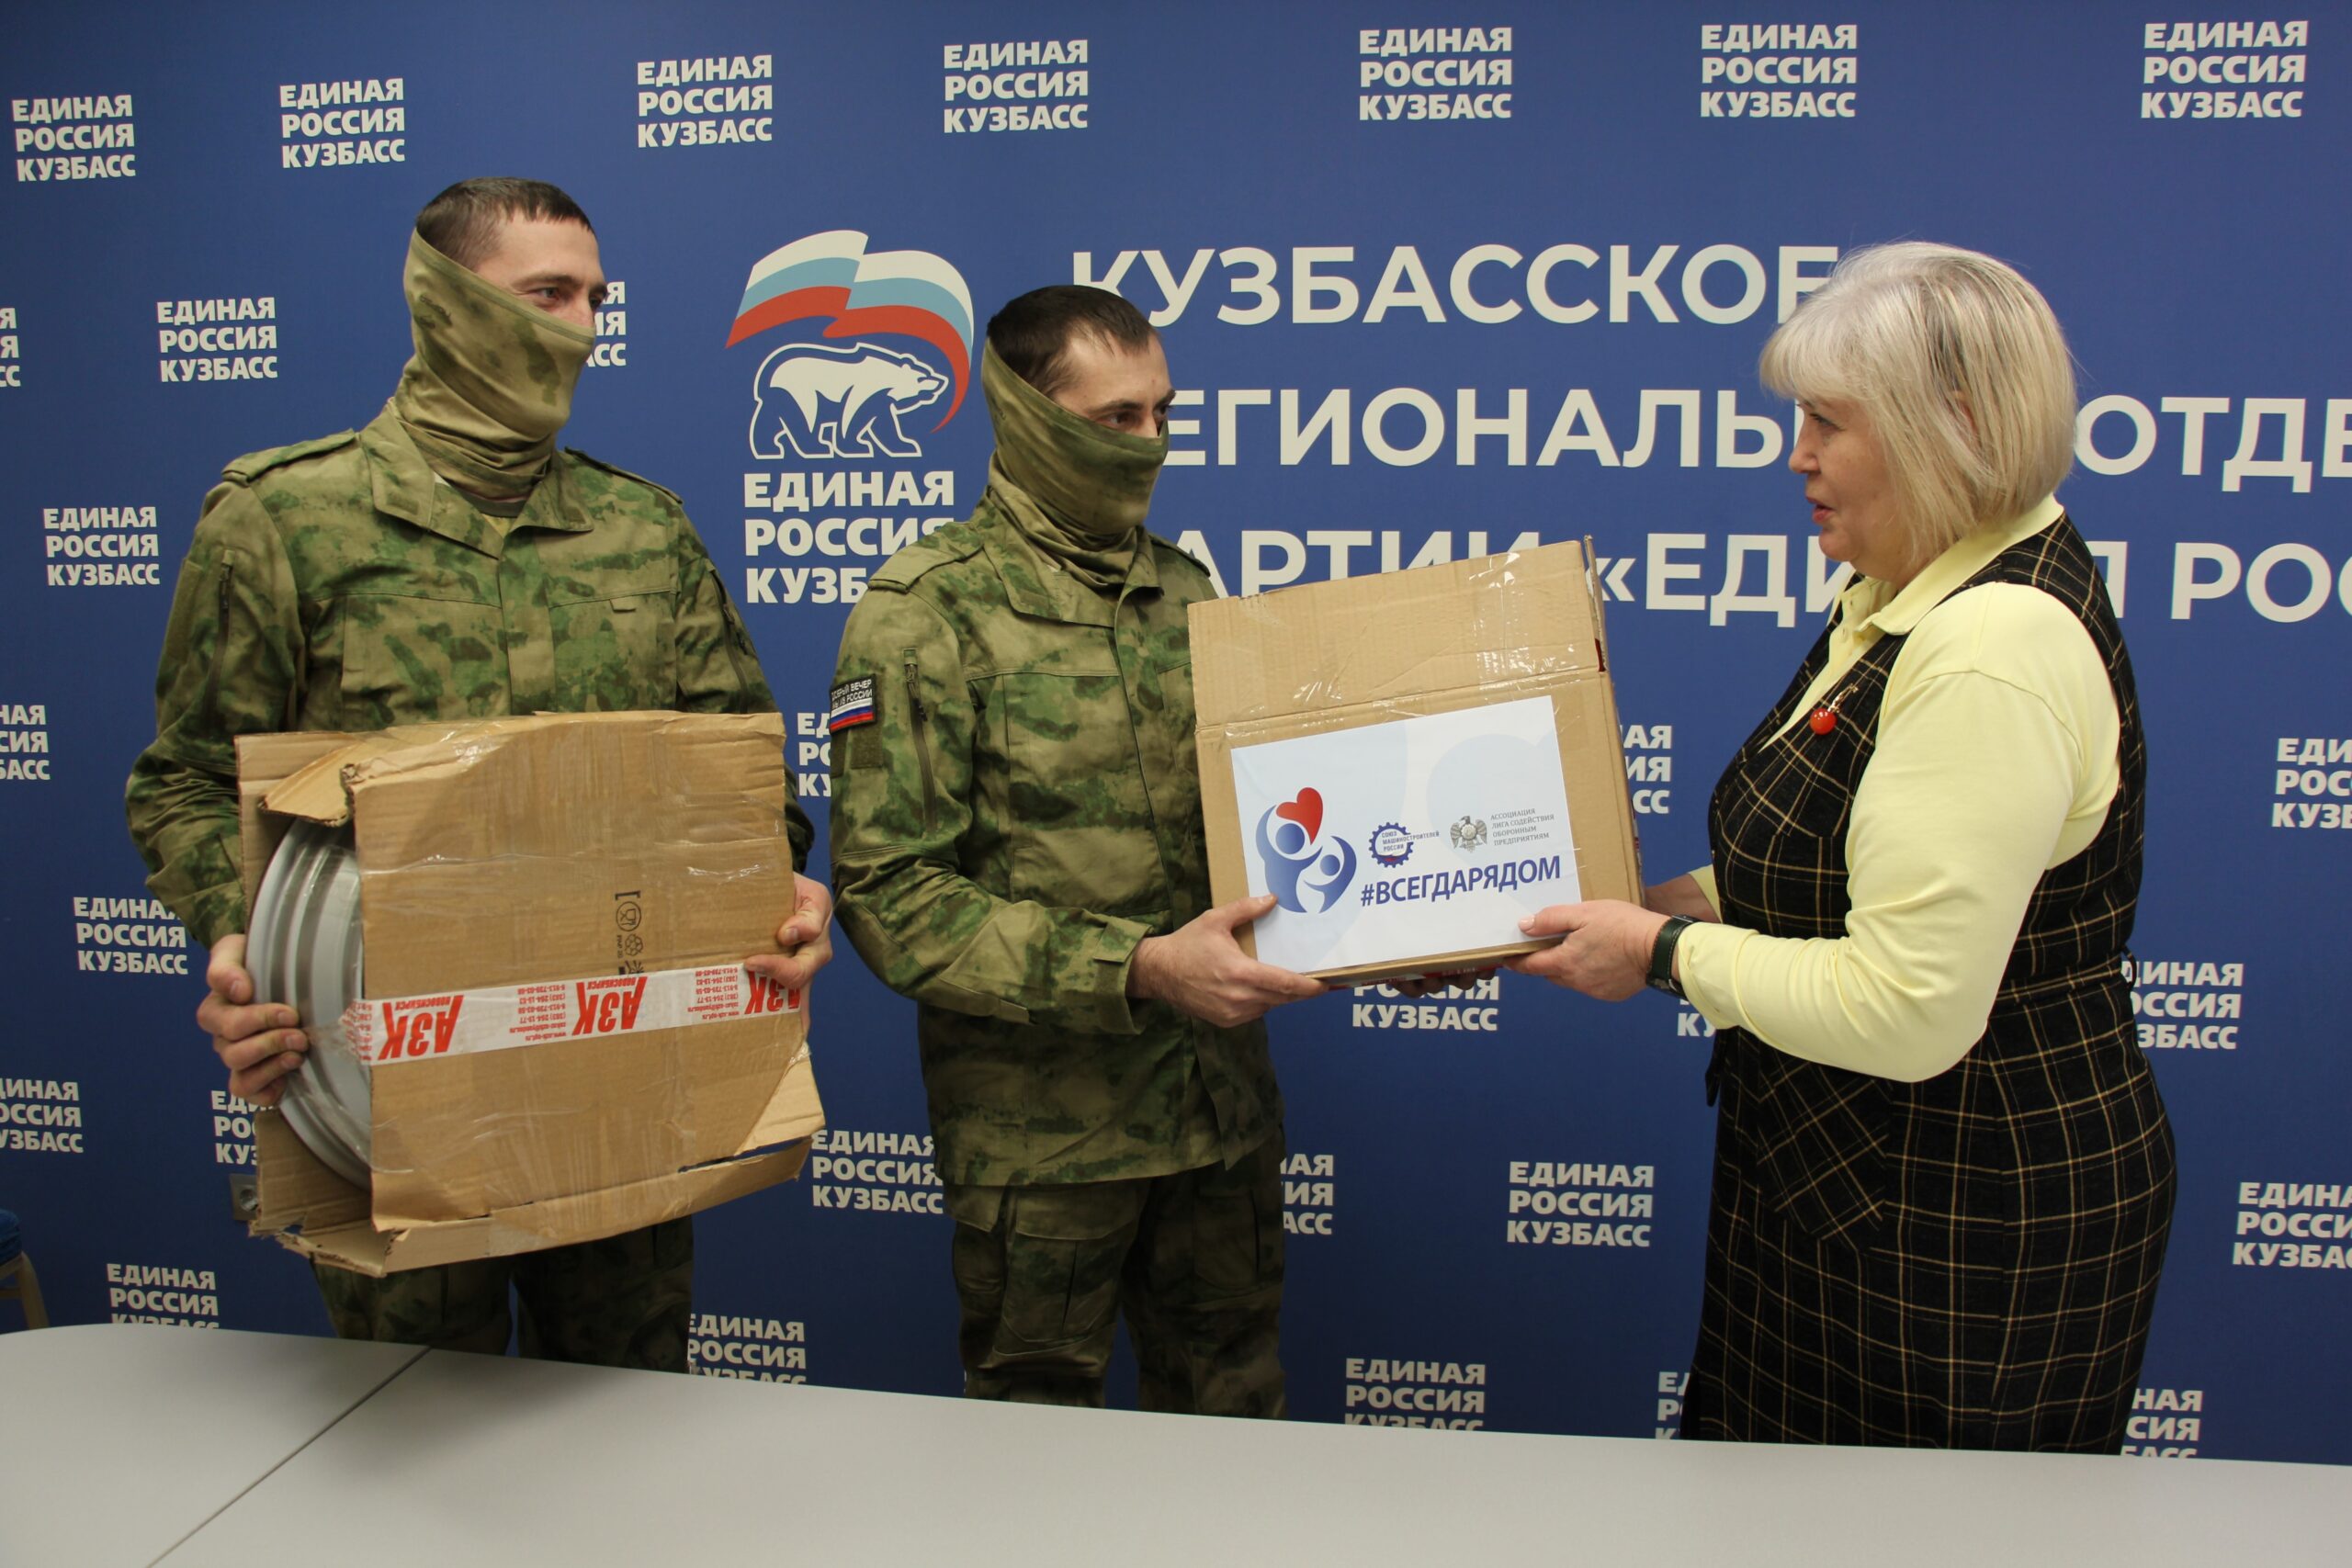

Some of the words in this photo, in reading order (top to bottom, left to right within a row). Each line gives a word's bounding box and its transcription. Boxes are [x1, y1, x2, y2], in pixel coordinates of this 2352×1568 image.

[1360, 28, 1511, 56] ЕДИНАЯ
[1702, 25, 1857, 52] ЕДИНАЯ
[2145, 20, 2308, 51] ЕДИНАЯ
[944, 39, 1088, 71] ЕДИНАЯ
[638, 54, 772, 86] ЕДИНАЯ
[1361, 59, 1512, 87] РОССИЯ
[1702, 57, 1857, 84] РОССИЯ
[2145, 54, 2306, 84] РОССИЯ
[279, 78, 403, 109] ЕДИНАЯ
[945, 71, 1088, 100] РОССИЯ
[12, 95, 132, 124] ЕДИНАЯ
[639, 85, 772, 116] РОССИЯ
[1360, 93, 1512, 120] КУЗБАСС
[1702, 91, 1856, 117] КУЗБАСС
[2143, 91, 2303, 118] КУЗБАСС
[281, 107, 404, 138] РОССИЯ
[944, 104, 1088, 132] КУЗБАСС
[16, 124, 134, 152] РОССИЯ
[638, 118, 772, 147] КУЗБАСС
[282, 139, 404, 168] КУЗБАСС
[17, 154, 135, 181] КУЗБАСС
[1073, 243, 1838, 326] КУЗБАССКОЕ
[157, 297, 275, 325] ЕДИНАЯ
[159, 326, 277, 353] РОССИЯ
[160, 356, 277, 382] КУЗБАСС
[1163, 387, 1804, 468] ЕГИОНАЛЬ
[744, 470, 954, 513] ЕДИНАЯ
[43, 507, 156, 531] ЕДИНАЯ
[46, 535, 158, 558] РОССИЯ
[47, 564, 160, 585] КУЗБАСС
[747, 567, 868, 604] КУЗБ
[2171, 542, 2352, 623] РО
[847, 689, 872, 702] РОССИИ
[851, 679, 872, 692] ВЕЧЕР
[1491, 808, 1535, 820] АССОЦИАЦИЯ
[1492, 821, 1510, 829] ЛИГА
[1510, 814, 1555, 826] СОДЕЙСТВИЯ
[1383, 830, 1439, 844] МАШИНОСТРОИТЕЛЕЙ
[1493, 826, 1536, 838] ОБОРОННЫМ
[1494, 832, 1549, 845] ПРЕДПРИЯТИЯМ
[1361, 855, 1560, 907] #ВСЕГДАРЯДОМ
[74, 897, 180, 920] ЕДИНА
[76, 923, 187, 948] РОССИЯ
[78, 951, 187, 975] КУЗБАСС
[2121, 961, 2244, 987] ДИНАЯ
[571, 976, 648, 1036] АЗК
[1352, 1004, 1498, 1031] КУЗБАСС
[2130, 990, 2242, 1019] ССИЯ
[378, 995, 464, 1061] АЗК
[2137, 1023, 2239, 1050] ЗБАСС
[811, 1130, 934, 1156] ЕДИНАЯ
[812, 1156, 944, 1186] РОССИЯ
[1510, 1162, 1653, 1187] ЕДИНАЯ
[812, 1185, 944, 1214] КУЗБАСС
[1510, 1190, 1652, 1217] РОССИЯ
[1508, 1221, 1650, 1247] КУЗБАСС
[107, 1264, 216, 1291] ЕДИНАЯ
[110, 1288, 219, 1315] РОССИЯ
[687, 1338, 807, 1369] РОССИЯ
[1346, 1358, 1486, 1385] ЕДИНАЯ
[1346, 1385, 1485, 1413] РОССИЯ
[2132, 1388, 2203, 1412] НАЯ
[2126, 1416, 2200, 1441] СИЯ
